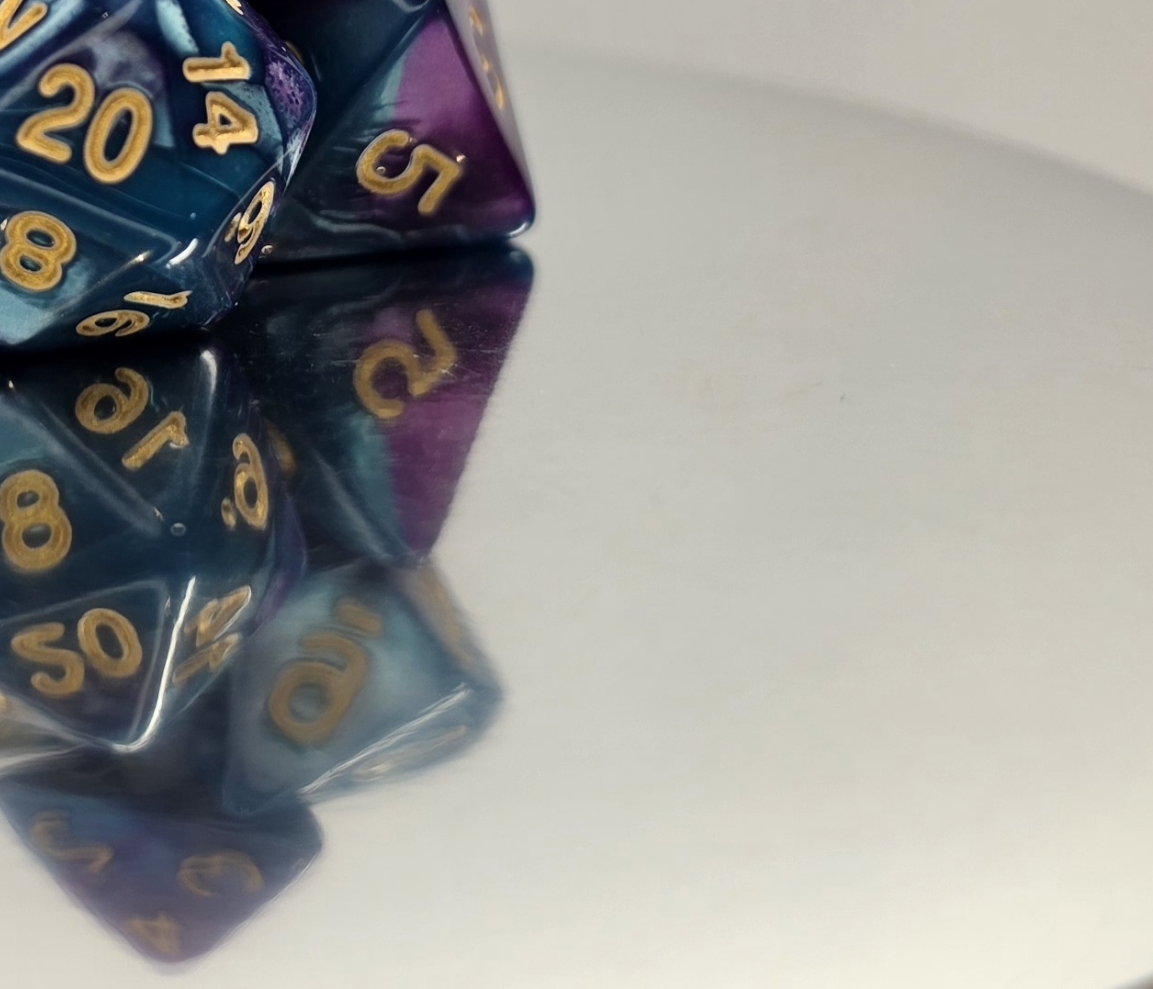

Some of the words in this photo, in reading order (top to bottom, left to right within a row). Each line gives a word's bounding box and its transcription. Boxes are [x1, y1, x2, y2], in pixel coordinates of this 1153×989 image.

[15, 62, 154, 184] 20
[182, 41, 259, 155] 14
[356, 129, 463, 217] 5
